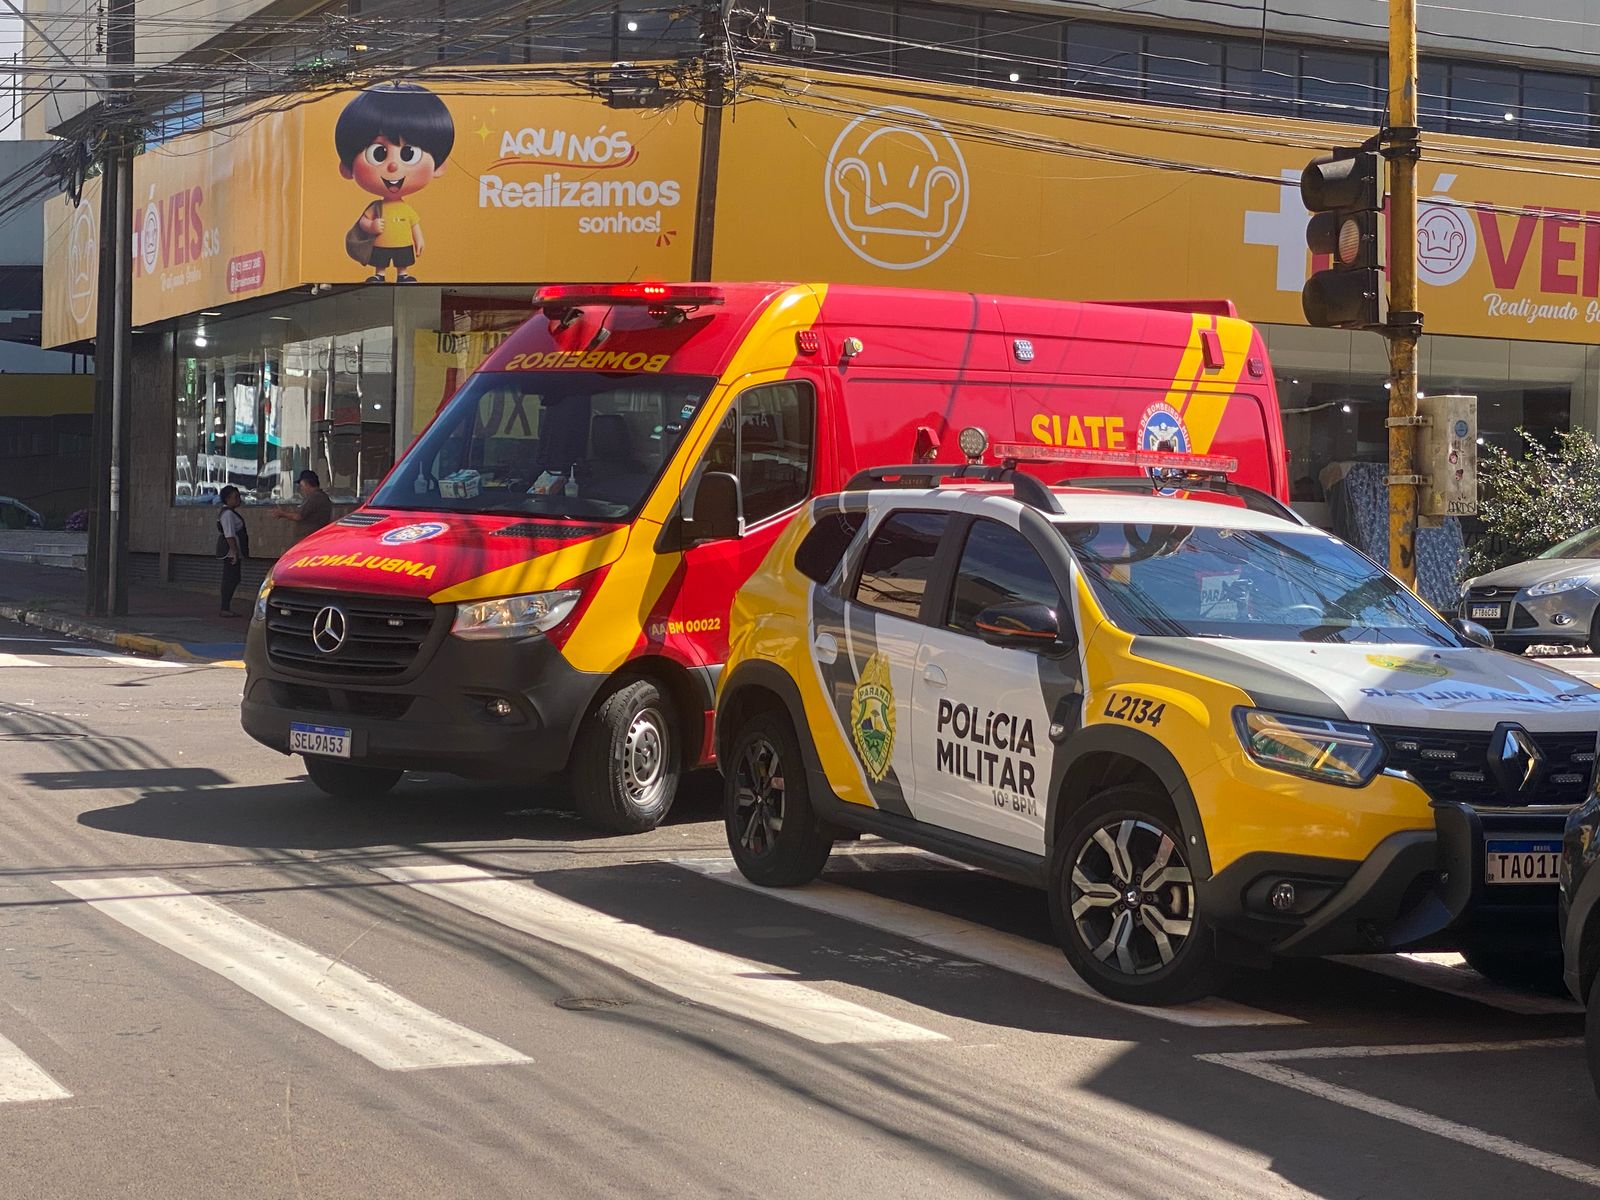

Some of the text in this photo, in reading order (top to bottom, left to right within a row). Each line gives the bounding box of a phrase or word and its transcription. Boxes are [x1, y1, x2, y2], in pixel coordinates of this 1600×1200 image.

[500, 124, 633, 163] AQUI NÓS
[479, 172, 680, 208] Realizamos
[578, 211, 661, 234] sonhos!
[1483, 293, 1579, 323] Realizando
[1031, 413, 1127, 449] SIATE
[686, 617, 721, 632] 00022
[1103, 692, 1166, 727] L2134
[294, 732, 343, 754] SEL9A53
[936, 739, 1036, 798] MILITAR
[1012, 795, 1038, 816] BPM
